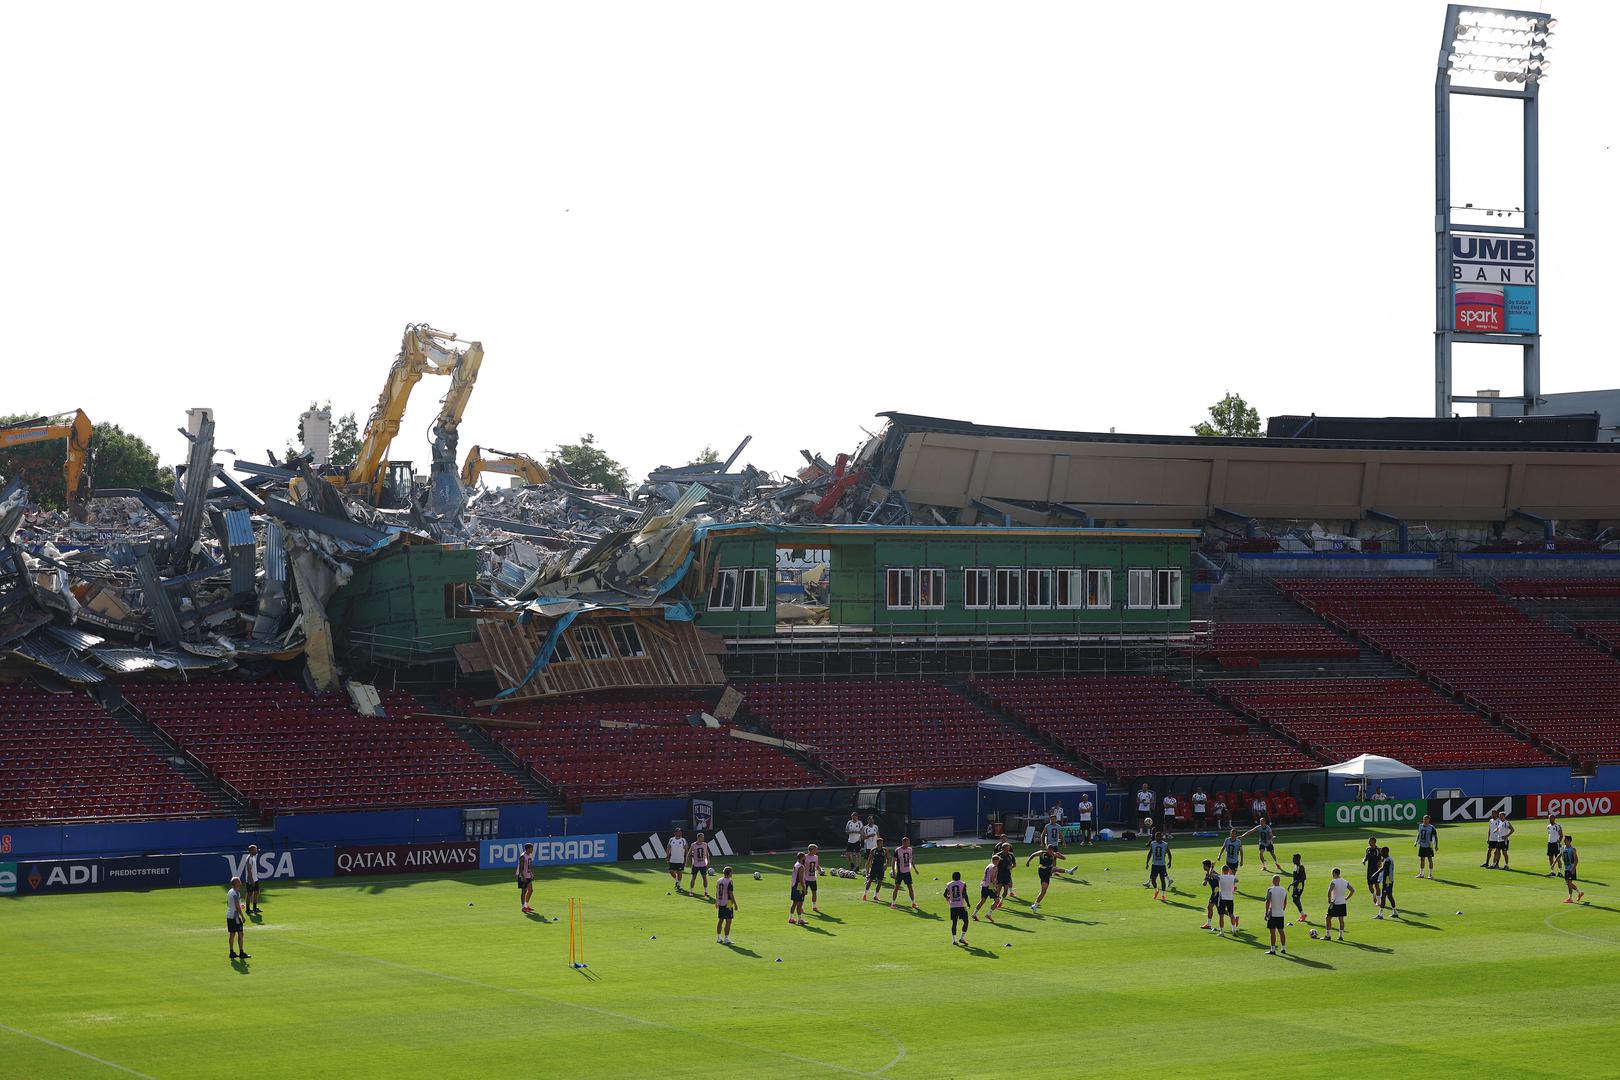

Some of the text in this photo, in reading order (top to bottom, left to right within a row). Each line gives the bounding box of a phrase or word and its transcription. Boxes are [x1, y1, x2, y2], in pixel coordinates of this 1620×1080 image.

[1453, 237, 1534, 260] UMB
[1453, 266, 1535, 283] BANK
[1460, 307, 1498, 326] spark
[99, 532, 112, 540] 108
[1336, 802, 1417, 823] aramco
[1537, 794, 1612, 816] Lenovo
[337, 848, 477, 872] QATAR AIRWAYS
[46, 864, 98, 886] ADI
[109, 867, 171, 877] PREDICTSTREET
